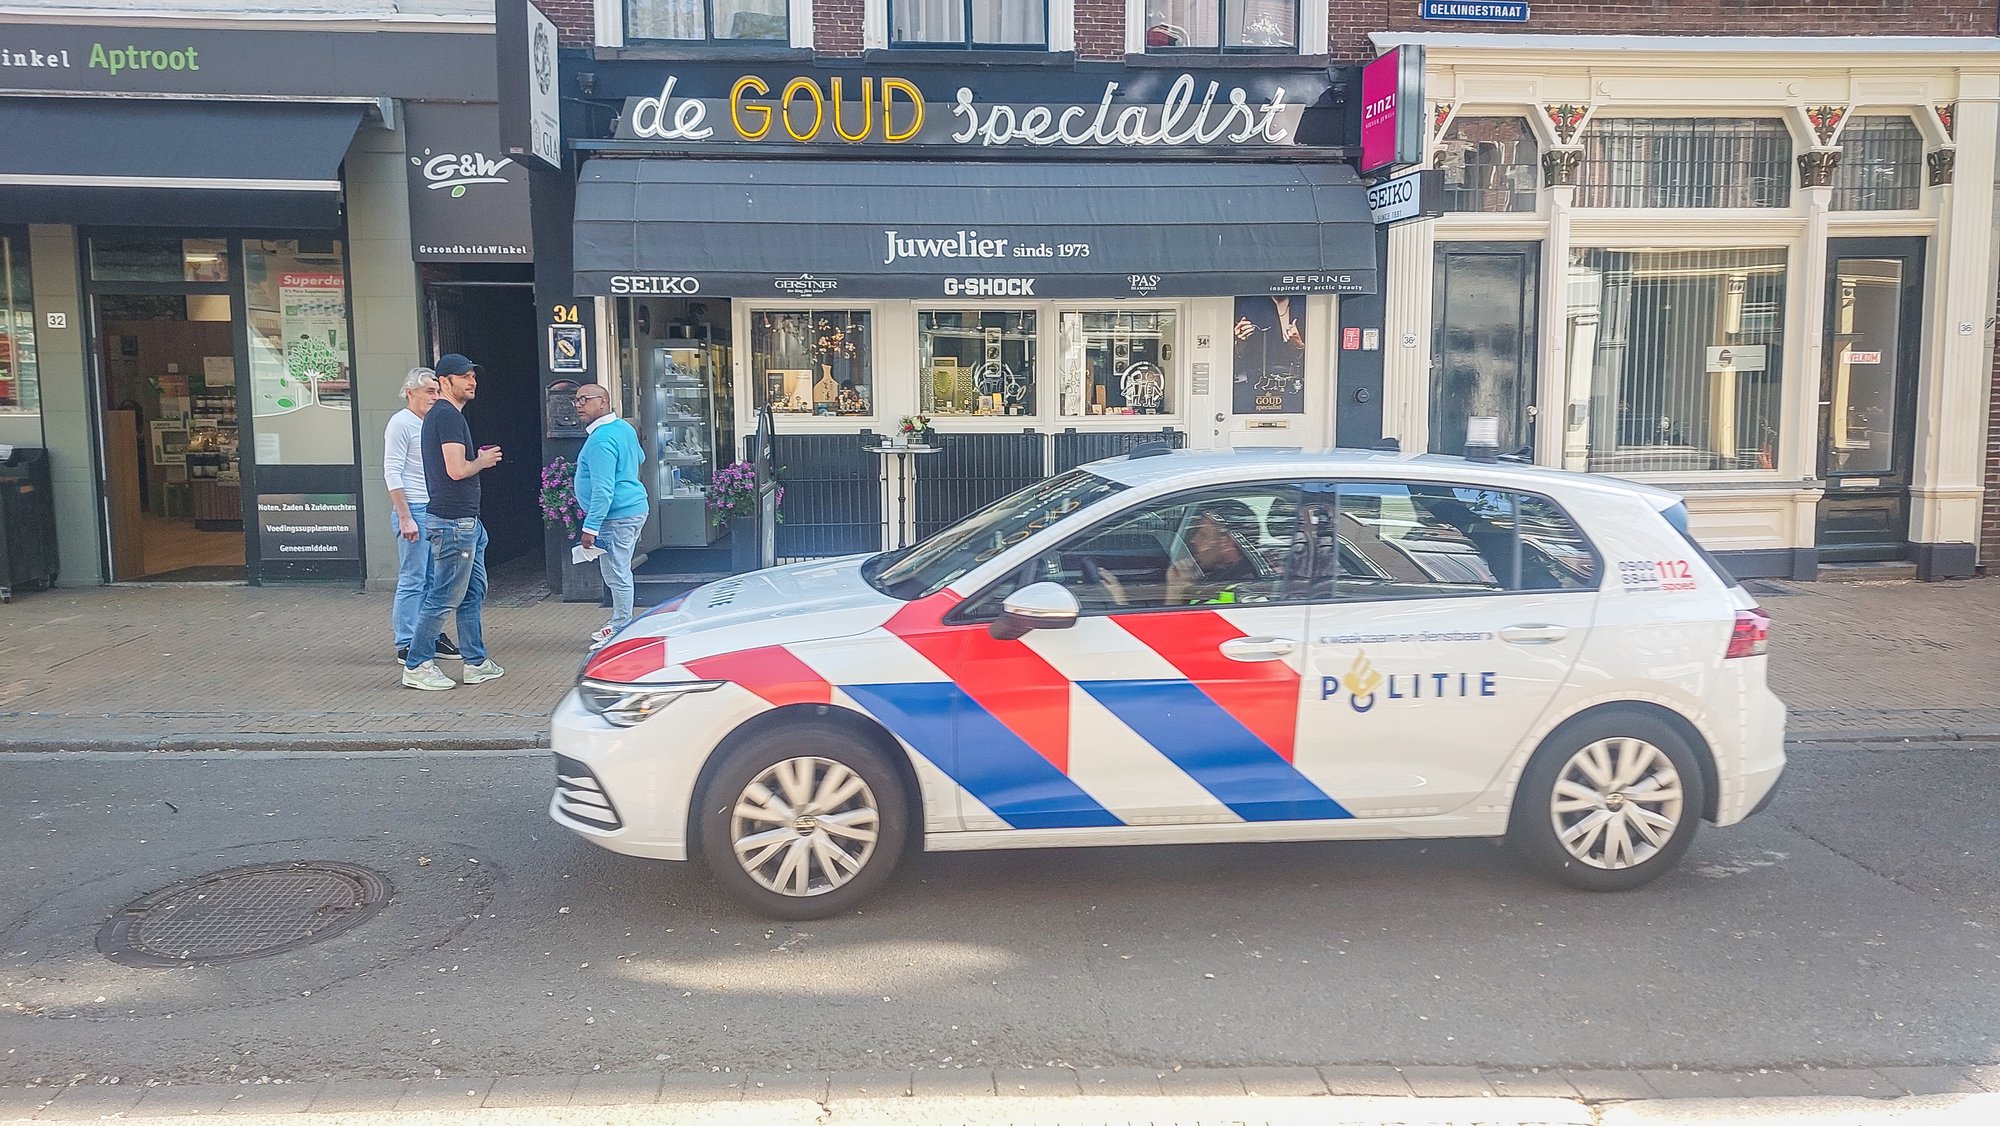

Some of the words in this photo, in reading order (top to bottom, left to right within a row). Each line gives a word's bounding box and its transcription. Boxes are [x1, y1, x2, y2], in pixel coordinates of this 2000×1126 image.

[1430, 4, 1522, 17] GELKINGESTRAAT
[88, 42, 200, 76] Aptroot
[632, 75, 715, 140] de
[729, 75, 926, 142] GOUD
[542, 131, 560, 163] GIA
[423, 152, 514, 181] G&W
[1368, 180, 1413, 211] SEIKO
[419, 245, 527, 254] GezondheidsWinkel
[883, 230, 1008, 264] Juwelier
[1013, 243, 1053, 258] sinds
[1057, 244, 1091, 257] 1973
[610, 275, 700, 295] SEIKO
[774, 280, 838, 289] GERSTNER
[943, 277, 1036, 296] G-SHOCK
[1131, 274, 1157, 287] PAS
[1282, 275, 1351, 284] BERING
[1269, 284, 1300, 292] inspired
[49, 315, 65, 326] 32
[553, 304, 579, 323] 34
[1255, 397, 1282, 405] GOUD
[282, 503, 304, 511] Zaden
[304, 503, 310, 511] &
[311, 503, 357, 511] Zuidvruchten
[266, 524, 350, 533] Voedingssupplementen
[280, 544, 339, 552] Geneesmiddelen
[1655, 560, 1693, 579] 112
[1320, 671, 1497, 714] POLITIE
